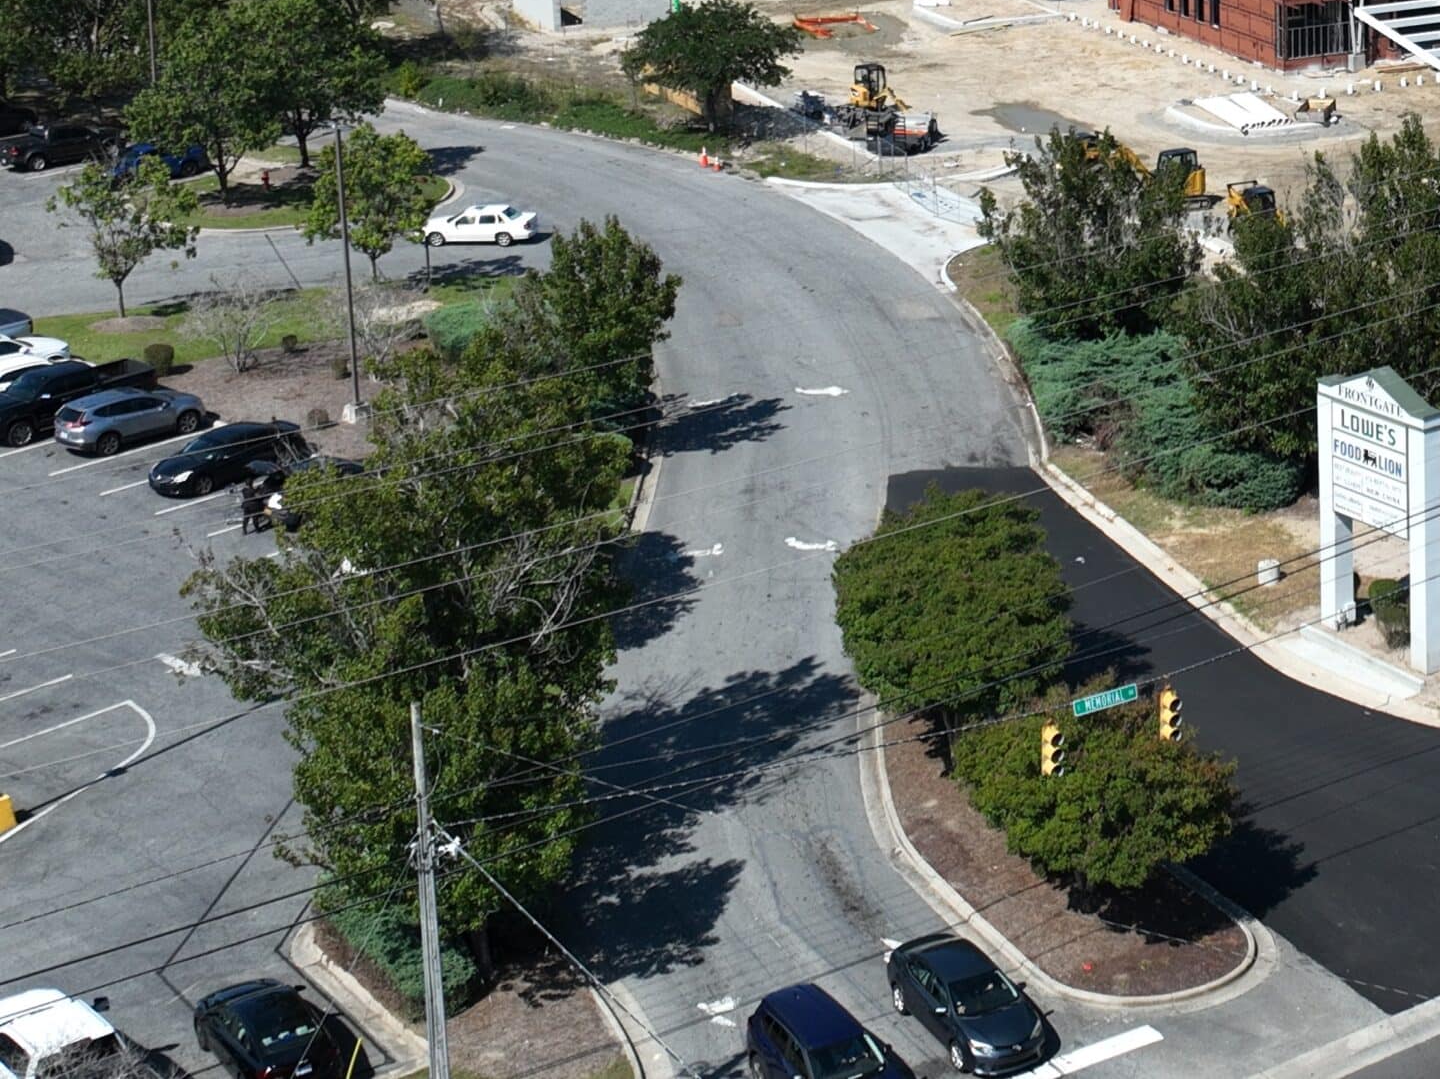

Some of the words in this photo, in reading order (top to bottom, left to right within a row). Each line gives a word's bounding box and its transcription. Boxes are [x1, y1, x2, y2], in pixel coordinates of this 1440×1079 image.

[1339, 384, 1403, 417] FRONTGATE
[1341, 408, 1396, 446] LOWE'S
[1334, 438, 1361, 461] FOOD
[1379, 454, 1402, 477] LION
[1085, 690, 1124, 712] MEMORIAL
